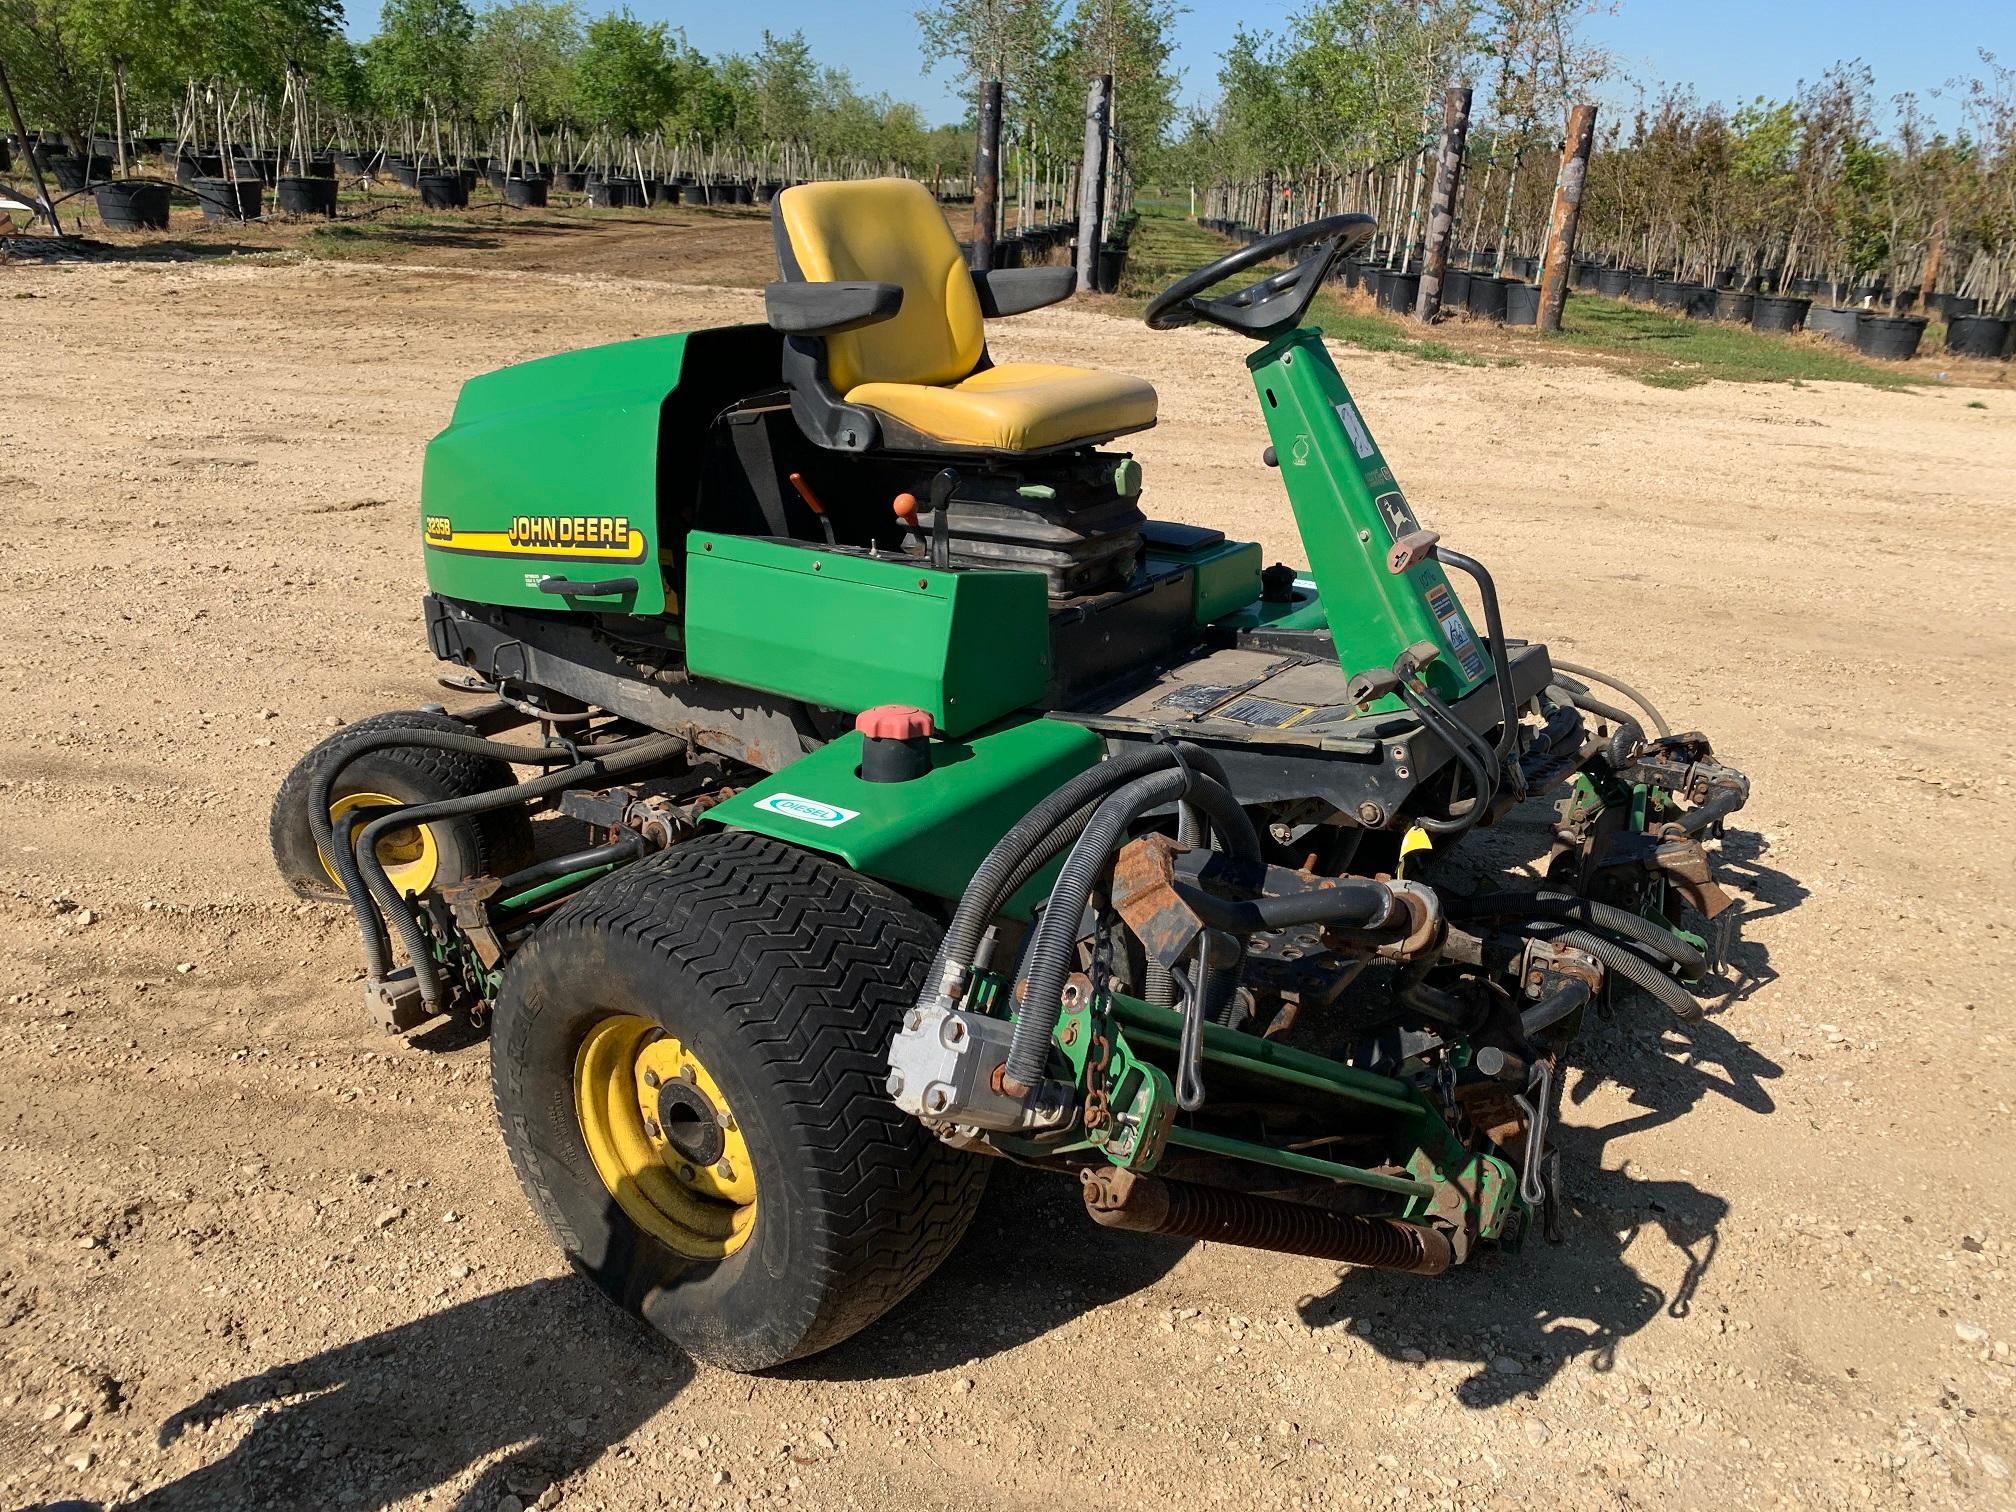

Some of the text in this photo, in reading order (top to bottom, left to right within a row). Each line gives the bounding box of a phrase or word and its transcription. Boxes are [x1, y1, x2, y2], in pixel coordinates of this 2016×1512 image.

[426, 515, 452, 537] 3235B
[508, 516, 629, 545] JOHN DEERE
[780, 801, 830, 819] DIESEL
